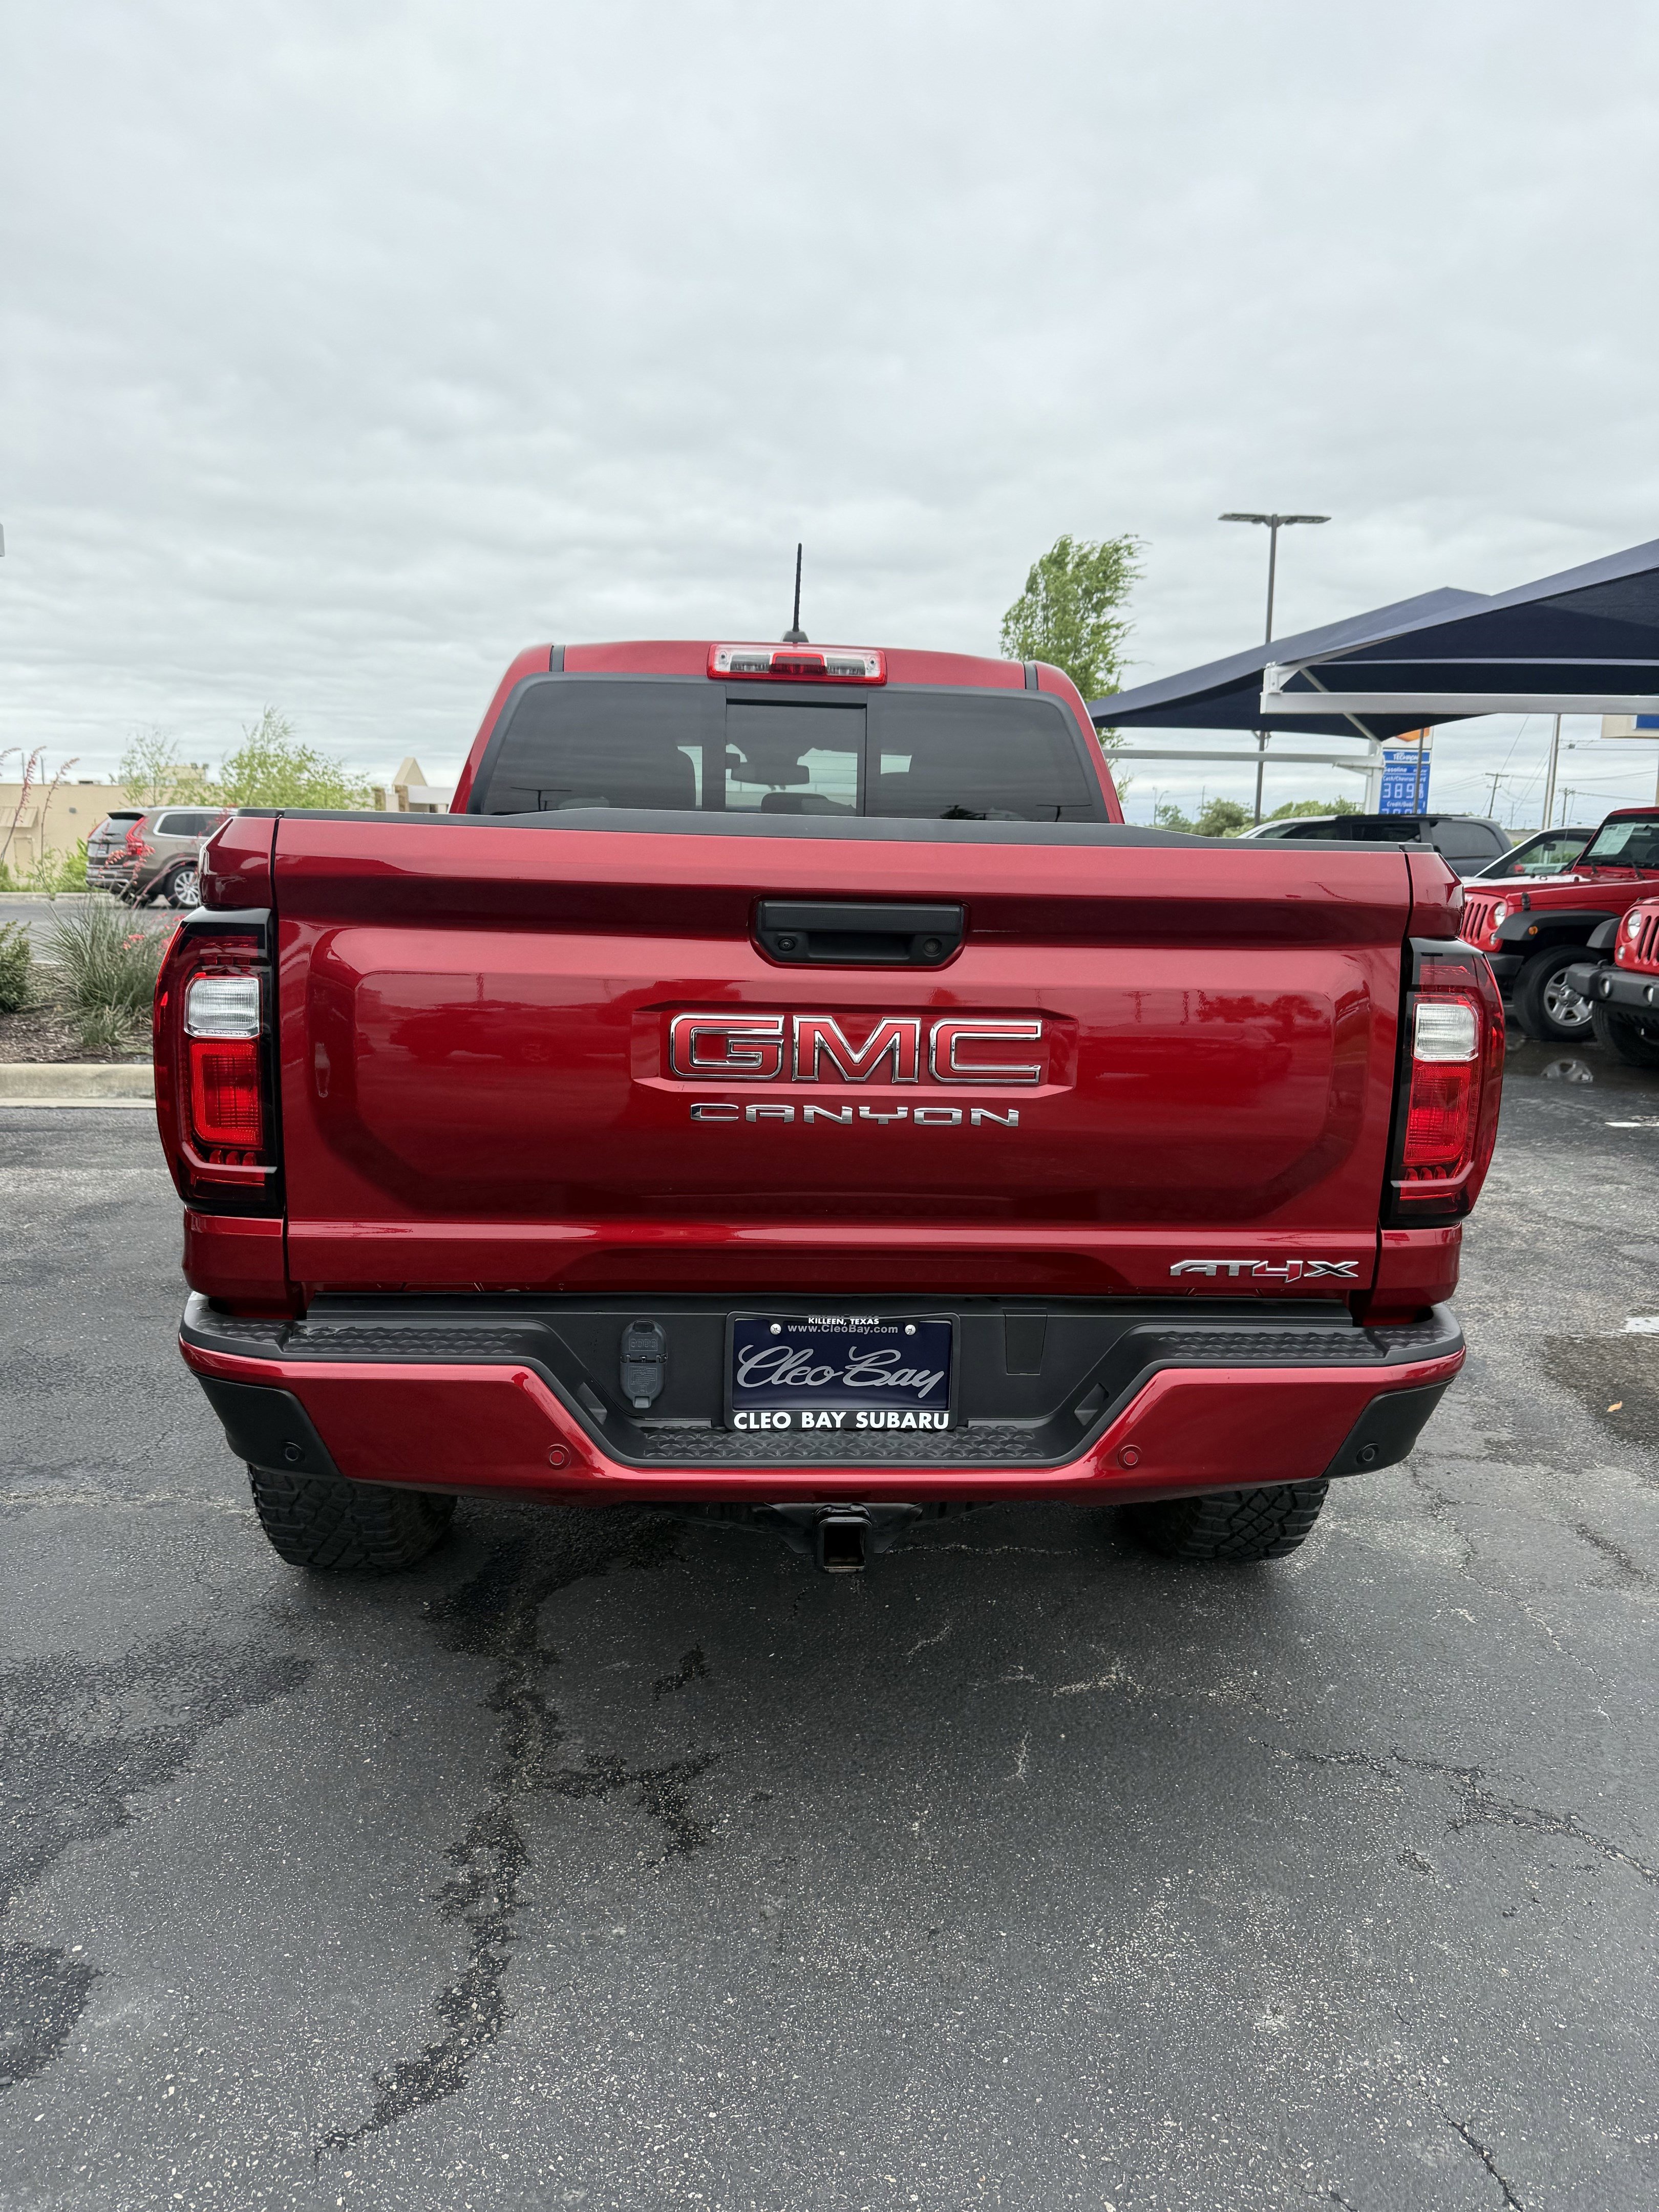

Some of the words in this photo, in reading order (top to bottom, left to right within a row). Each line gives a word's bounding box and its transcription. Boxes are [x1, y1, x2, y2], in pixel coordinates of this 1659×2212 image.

[1382, 783, 1414, 798] 389
[670, 1012, 1043, 1084] GMC
[690, 1102, 1019, 1127] CANYON
[1170, 1260, 1359, 1283] AT4X
[787, 1324, 898, 1334] www.CleoBay.com
[807, 1317, 847, 1326] KILLEEN,
[736, 1345, 843, 1388] Cleo
[842, 1346, 945, 1398] Bay
[733, 1412, 792, 1429] CLEO
[801, 1412, 847, 1429] BAY
[855, 1411, 950, 1429] SUBARU
